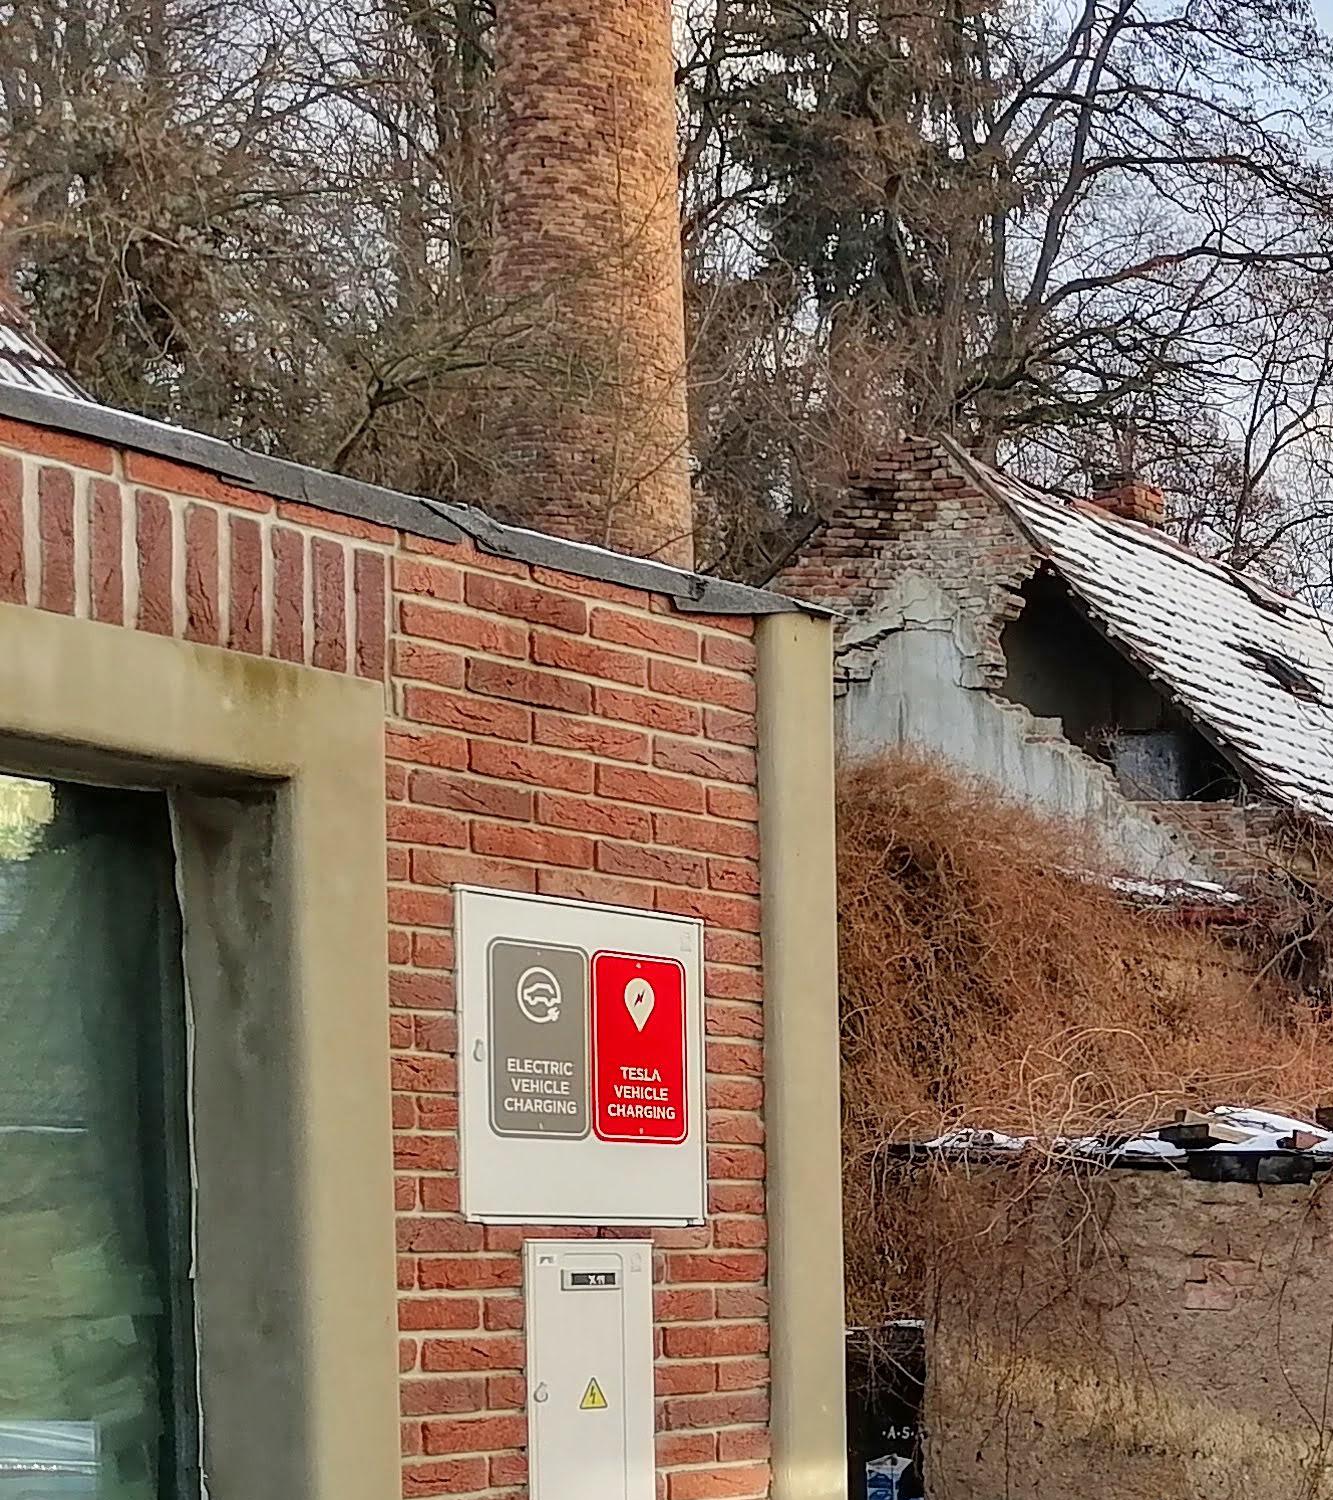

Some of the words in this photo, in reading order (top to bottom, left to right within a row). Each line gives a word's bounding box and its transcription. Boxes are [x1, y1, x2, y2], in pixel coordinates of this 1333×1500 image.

[507, 1058, 573, 1075] ELECTRIC
[620, 1066, 661, 1082] TESLA
[511, 1078, 569, 1095] VEHICLE
[613, 1085, 669, 1101] VEHICLE
[503, 1098, 577, 1114] CHARGING
[607, 1104, 675, 1119] CHARGING
